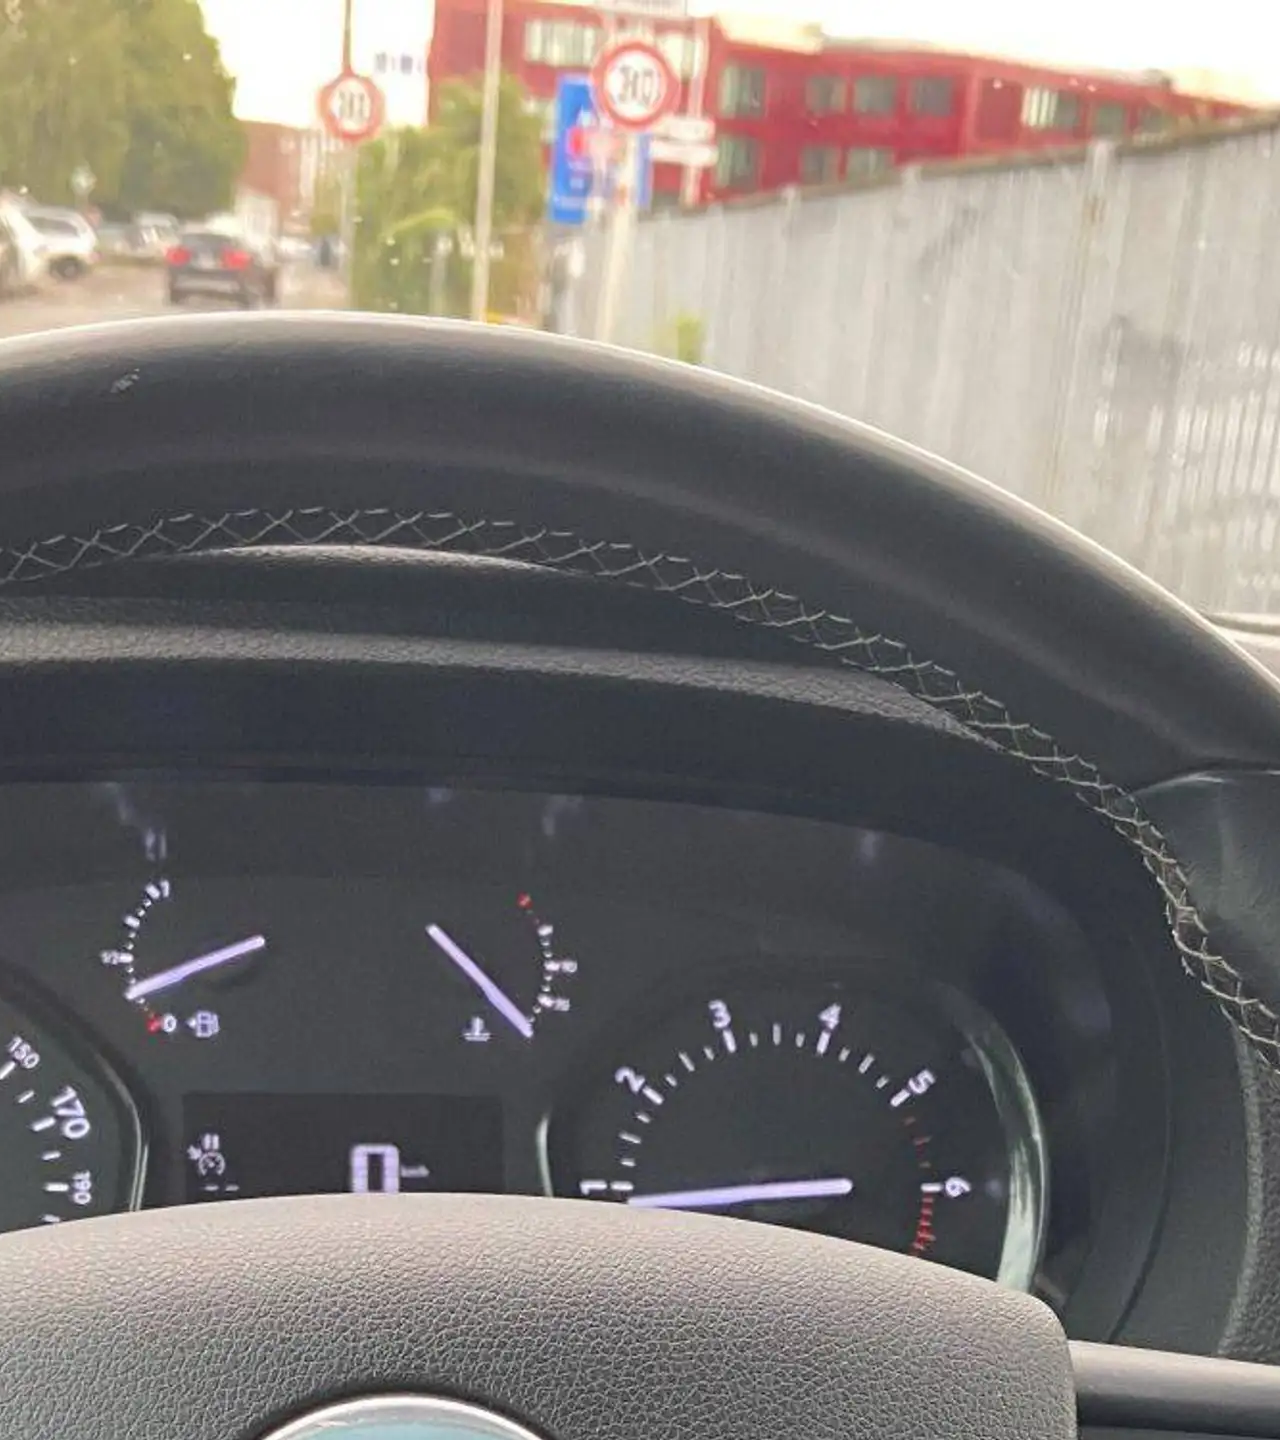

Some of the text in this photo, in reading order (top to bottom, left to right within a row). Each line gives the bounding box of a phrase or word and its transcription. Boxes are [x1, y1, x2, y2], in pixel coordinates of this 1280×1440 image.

[709, 1000, 731, 1028] 3
[818, 1003, 841, 1028] 4
[7, 1035, 40, 1070] 150
[615, 1066, 646, 1094] 2
[909, 1069, 936, 1096] 5
[52, 1086, 91, 1140] 170
[580, 1179, 608, 1195] 1
[944, 1176, 971, 1198] 6
